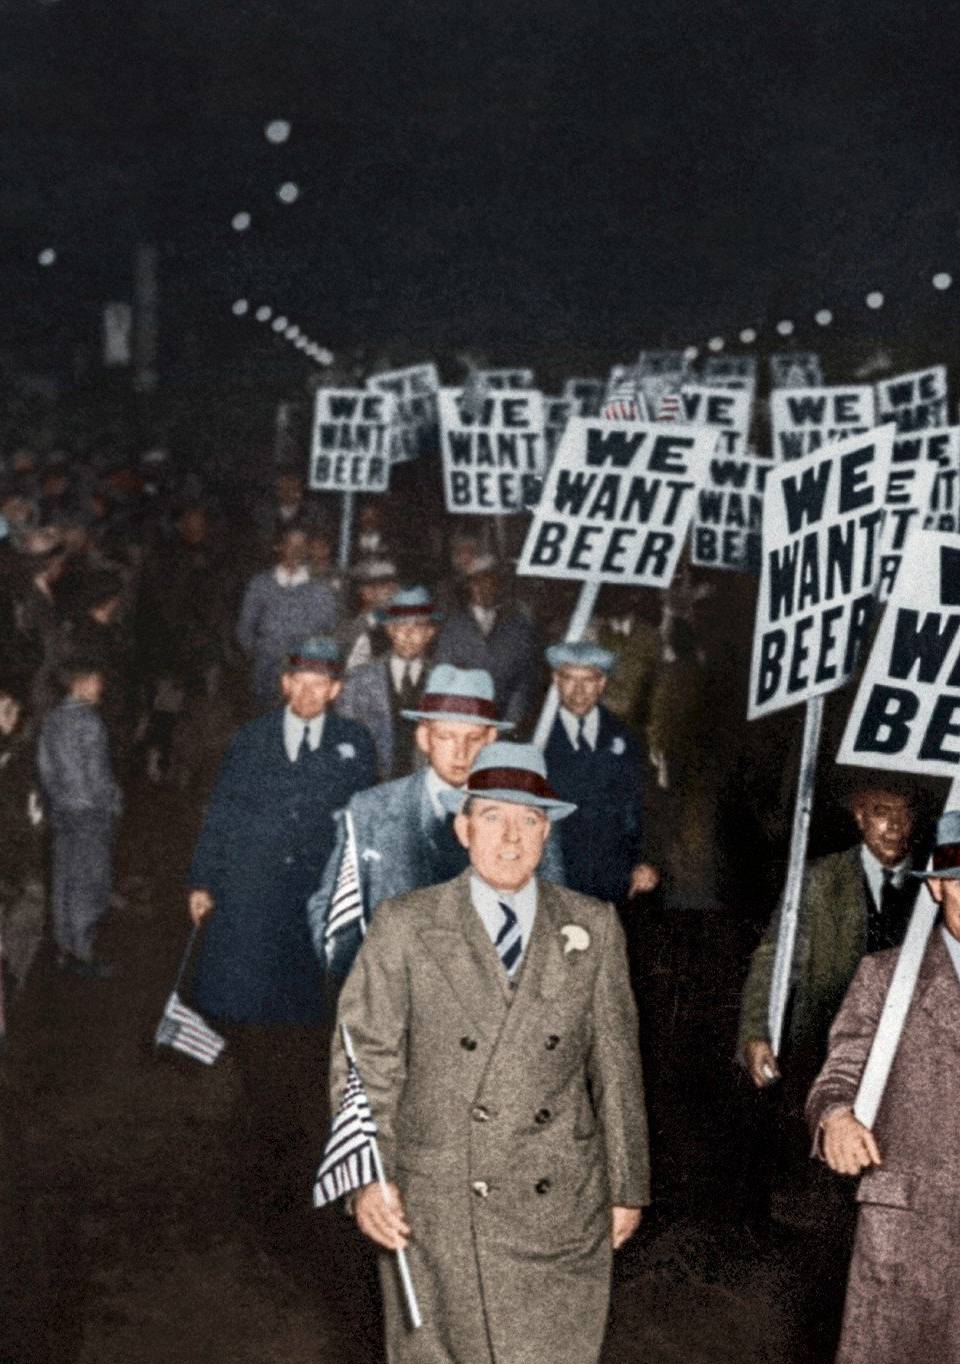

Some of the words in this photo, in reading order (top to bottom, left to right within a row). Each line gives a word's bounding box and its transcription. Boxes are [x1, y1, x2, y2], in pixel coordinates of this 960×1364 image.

[786, 396, 860, 426] WE
[449, 432, 539, 469] WANT
[584, 428, 695, 474] WE
[554, 470, 695, 525] WANT
[781, 444, 875, 535] WE
[529, 521, 675, 576] BEER
[768, 507, 882, 623] WANT
[756, 594, 880, 705] BEER
